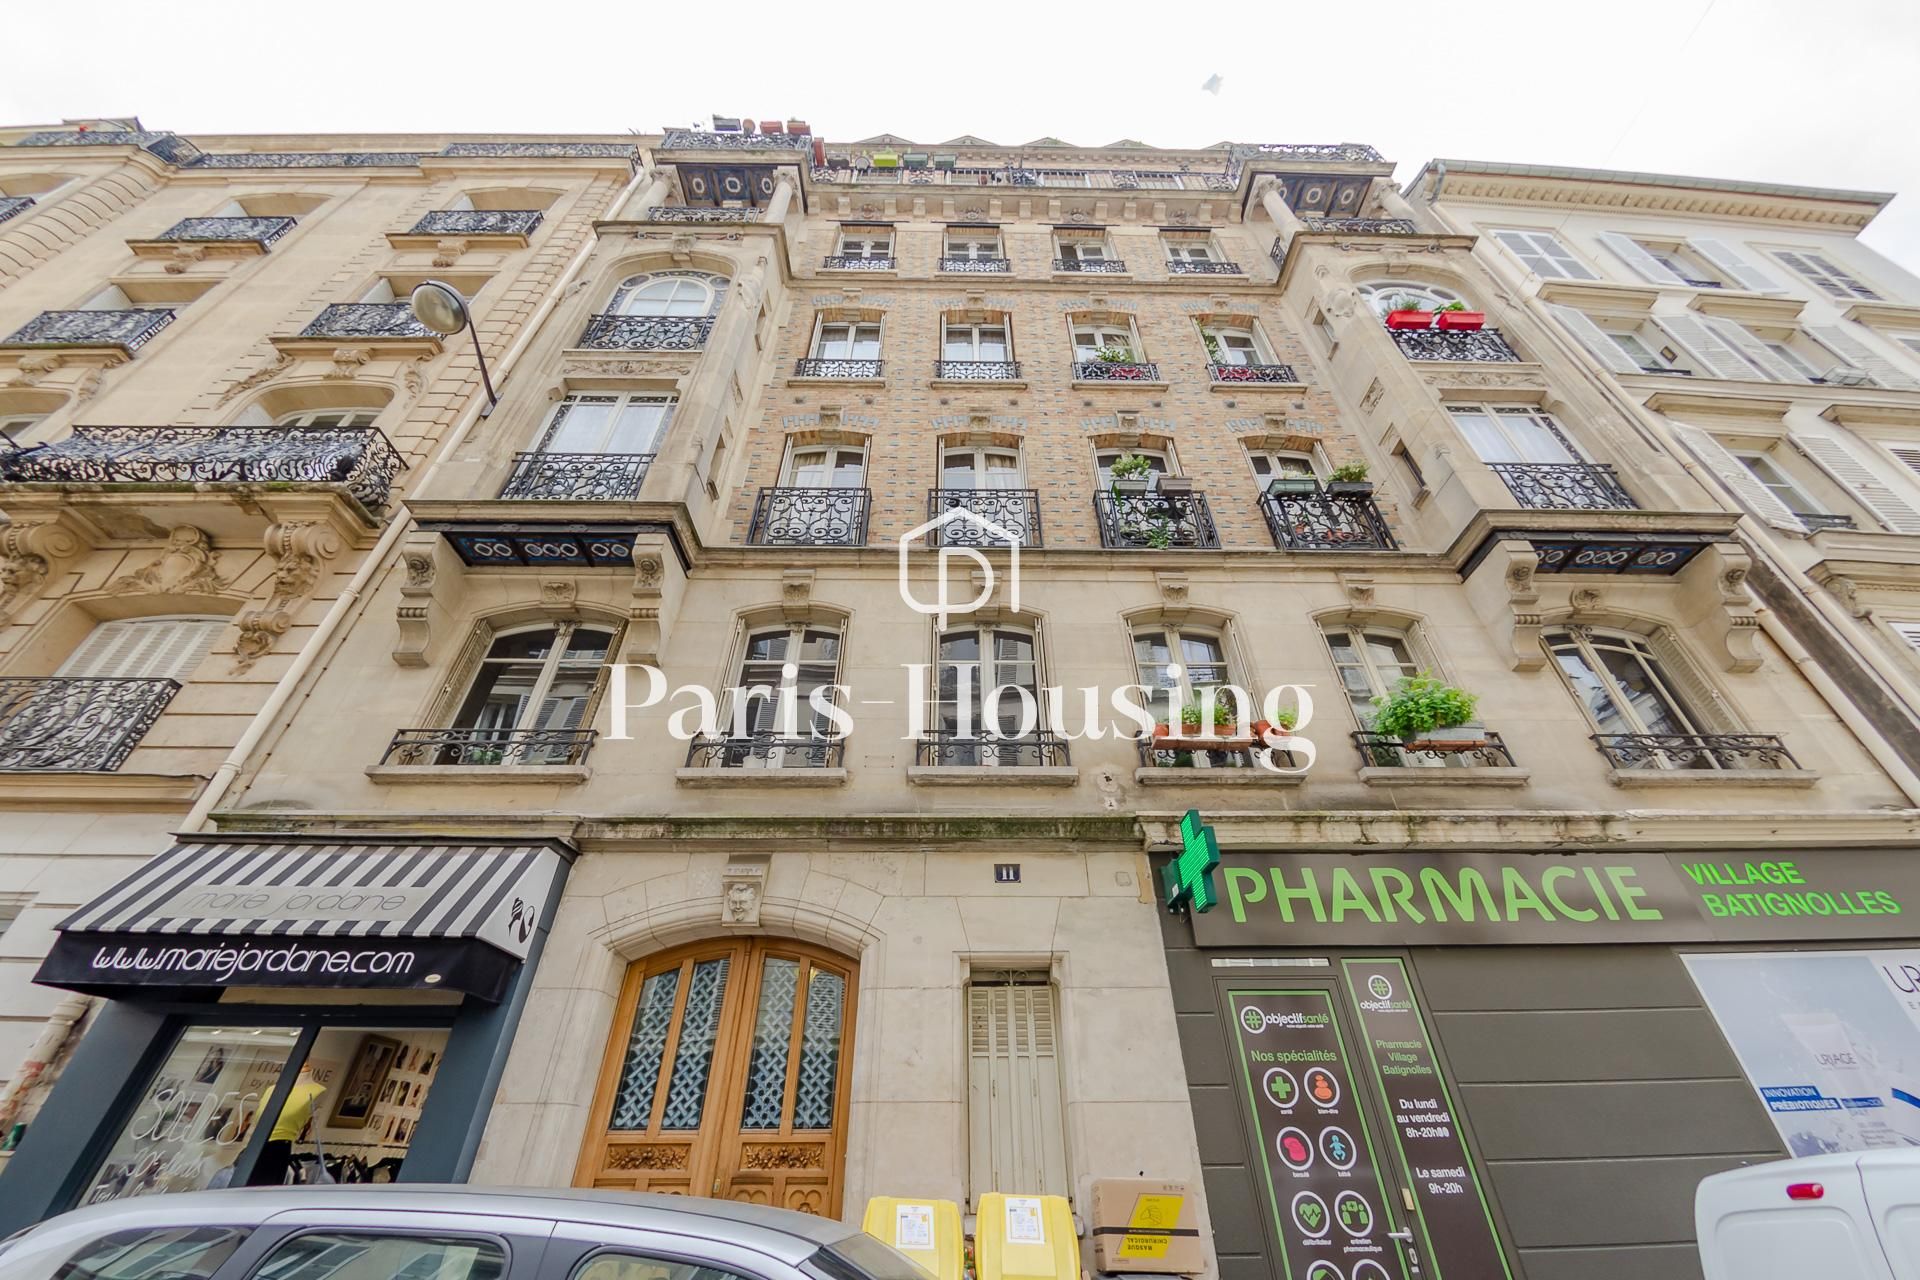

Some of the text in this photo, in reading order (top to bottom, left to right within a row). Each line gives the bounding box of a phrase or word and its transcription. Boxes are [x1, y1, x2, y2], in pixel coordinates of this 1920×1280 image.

[1002, 866, 1015, 880] 11
[1681, 862, 1806, 885] VILLAGE
[1223, 866, 1664, 924] PHARMACIE
[184, 888, 406, 918] marie jordane
[1701, 890, 1902, 917] BATIGNOLLES
[92, 943, 415, 982] www.mariejordane.com
[1376, 1040, 1422, 1049] Pharmacie
[1250, 1049, 1337, 1063] Nos spécialités
[1388, 1052, 1417, 1063] Village
[1382, 1065, 1432, 1076] Batignolles
[1762, 1087, 1817, 1097] INNOVATION
[1399, 1099, 1438, 1109] Du lundi
[131, 1088, 258, 1146] SOLDES
[1396, 1112, 1450, 1123] au vendredi
[1416, 1166, 1466, 1178] Le samedi
[1428, 1183, 1463, 1194] 9h-20h
